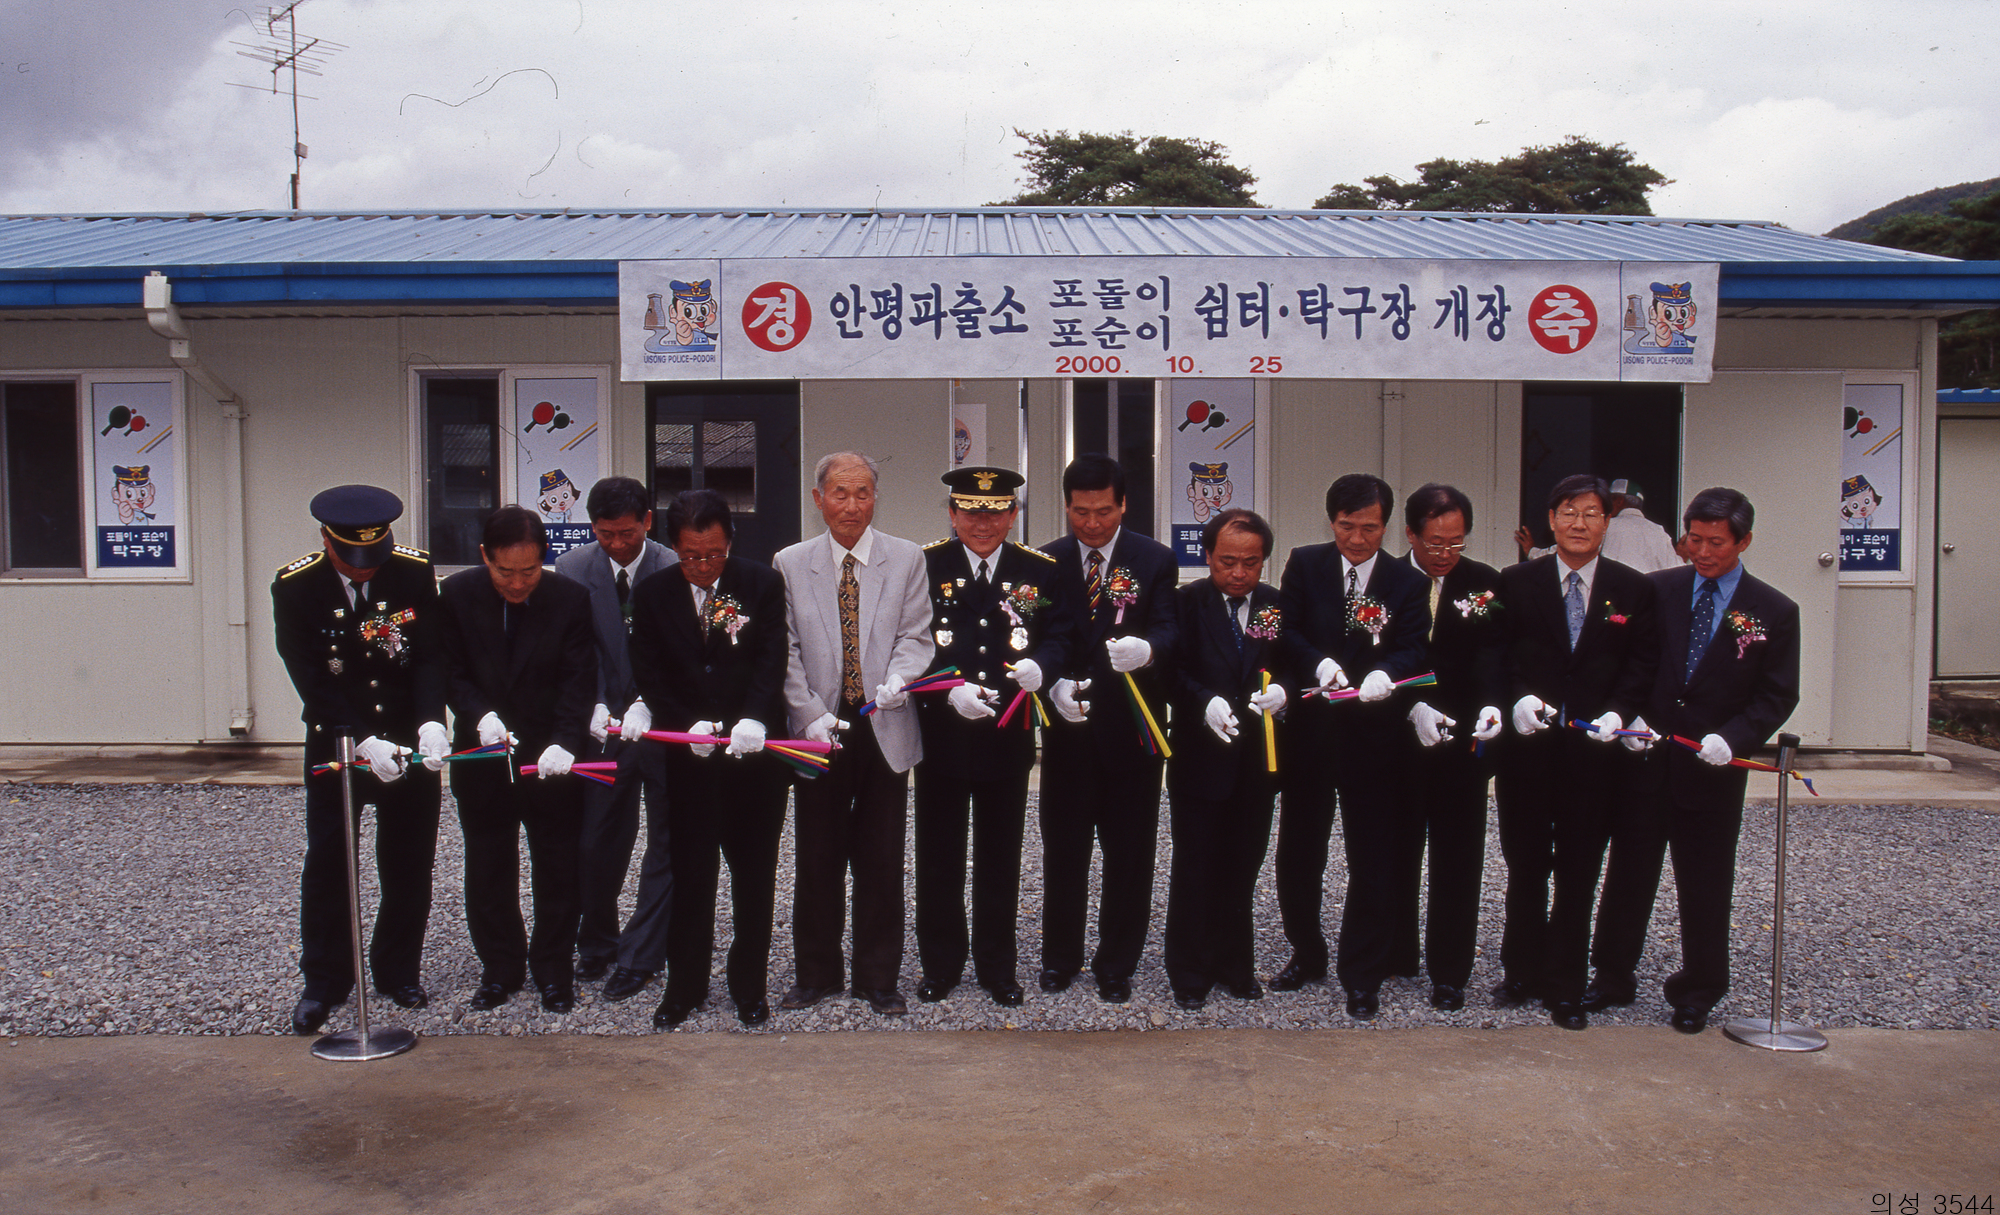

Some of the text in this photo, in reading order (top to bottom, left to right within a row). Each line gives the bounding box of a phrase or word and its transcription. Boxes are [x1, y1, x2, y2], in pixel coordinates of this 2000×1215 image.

[748, 288, 796, 346] 경
[829, 281, 1029, 341] 안평파출소
[1049, 275, 1170, 312] 포돌이
[1433, 284, 1512, 342] 개장
[1049, 314, 1170, 352] 포순이
[1535, 291, 1591, 350] 축
[1055, 355, 1283, 374] 2000. 10. 25
[112, 544, 164, 558] 탁구장
